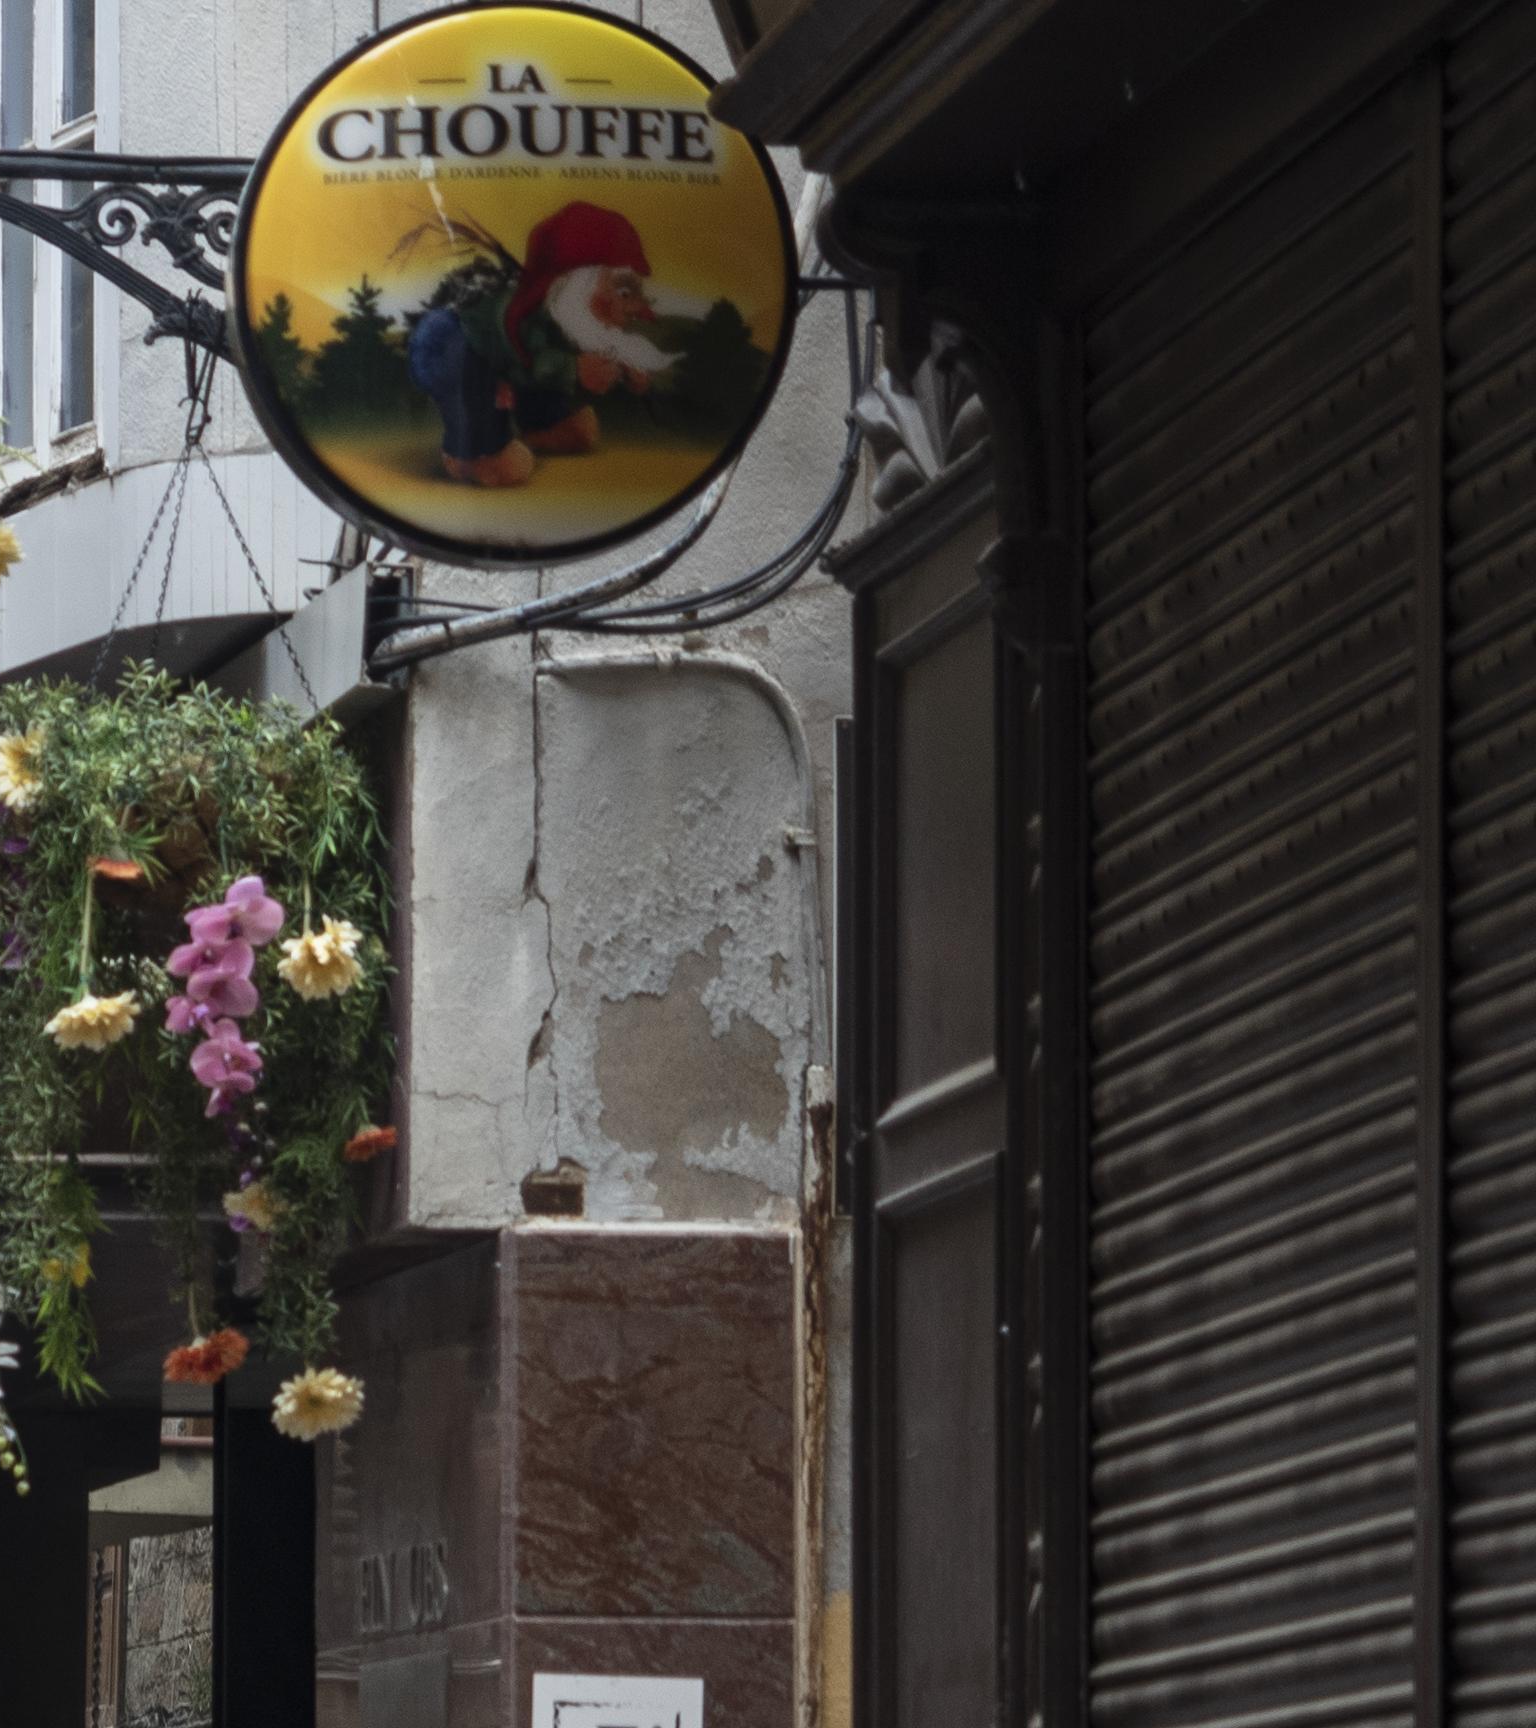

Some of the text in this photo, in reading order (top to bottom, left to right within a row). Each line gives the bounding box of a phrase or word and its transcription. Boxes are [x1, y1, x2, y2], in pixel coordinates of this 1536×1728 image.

[487, 63, 546, 94] LA
[317, 103, 715, 164] CHOUFFE
[376, 167, 441, 182] BLONE
